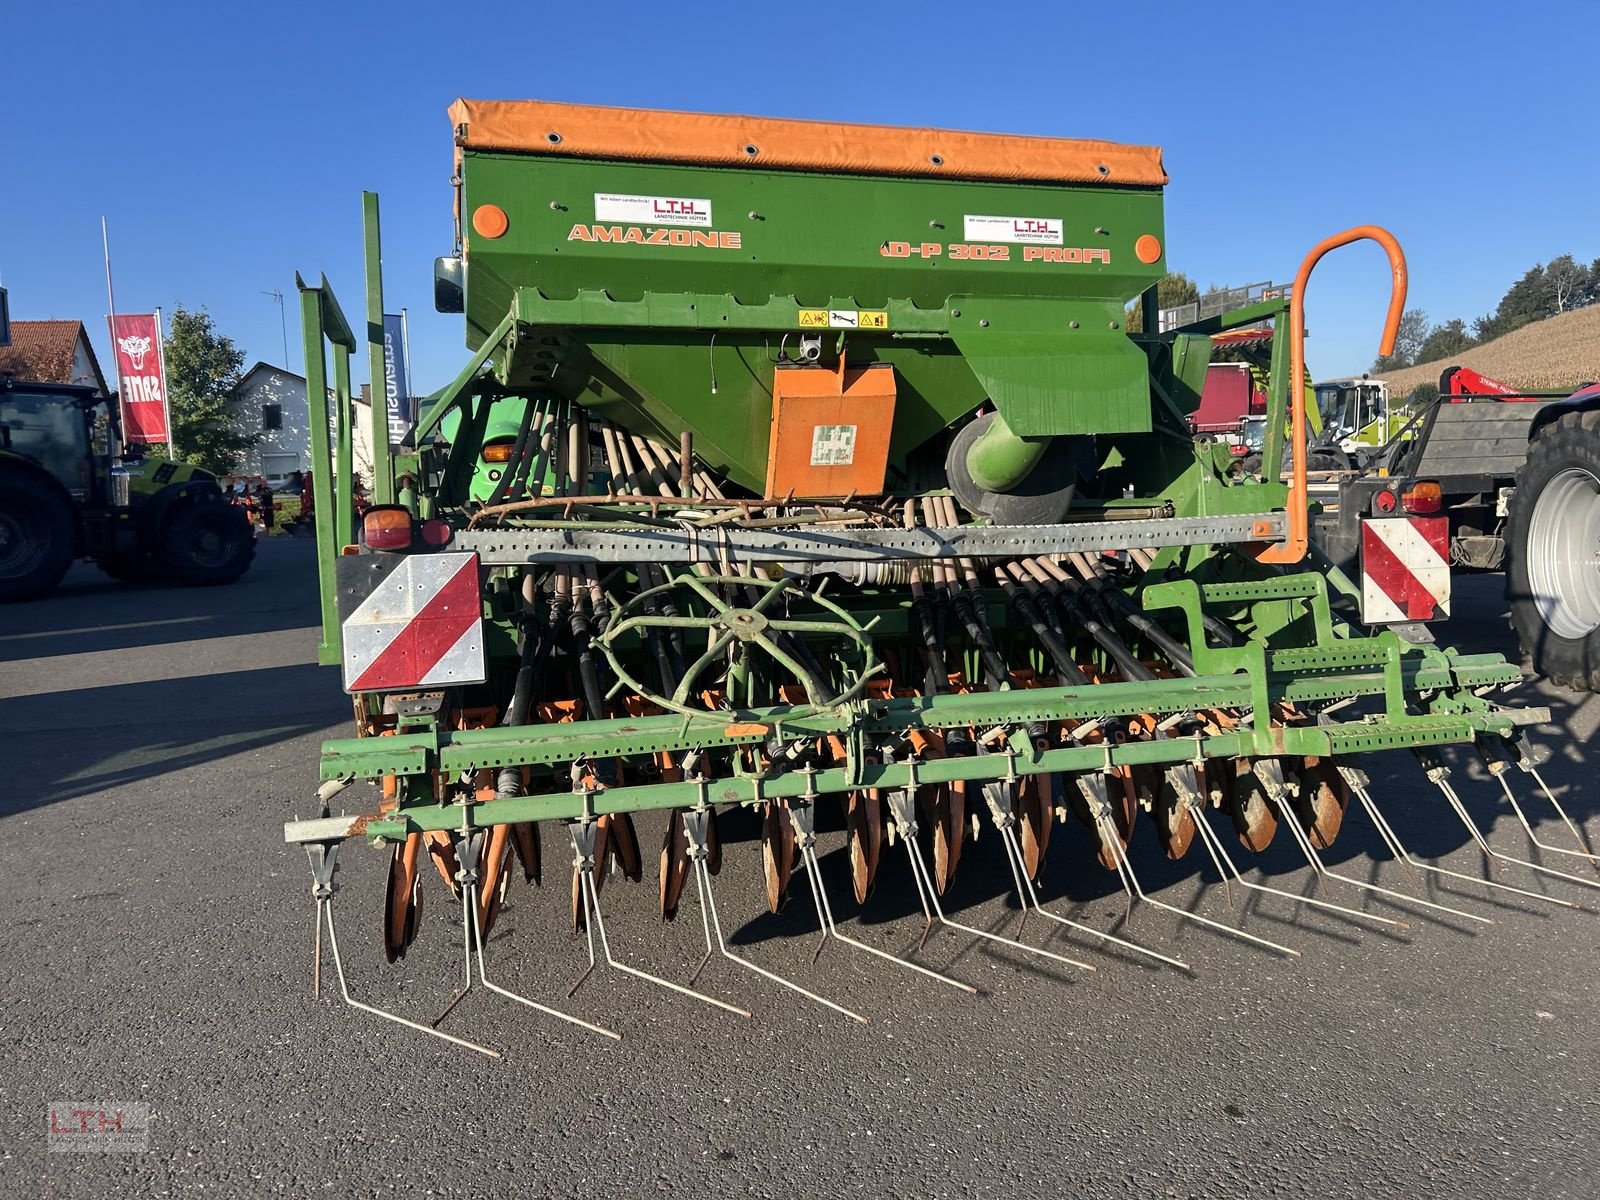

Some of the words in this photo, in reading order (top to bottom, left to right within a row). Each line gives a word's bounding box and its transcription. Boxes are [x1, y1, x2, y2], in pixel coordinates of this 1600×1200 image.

[567, 223, 742, 249] AMAZONE
[948, 244, 1010, 261] 302
[1023, 246, 1111, 264] PROFI
